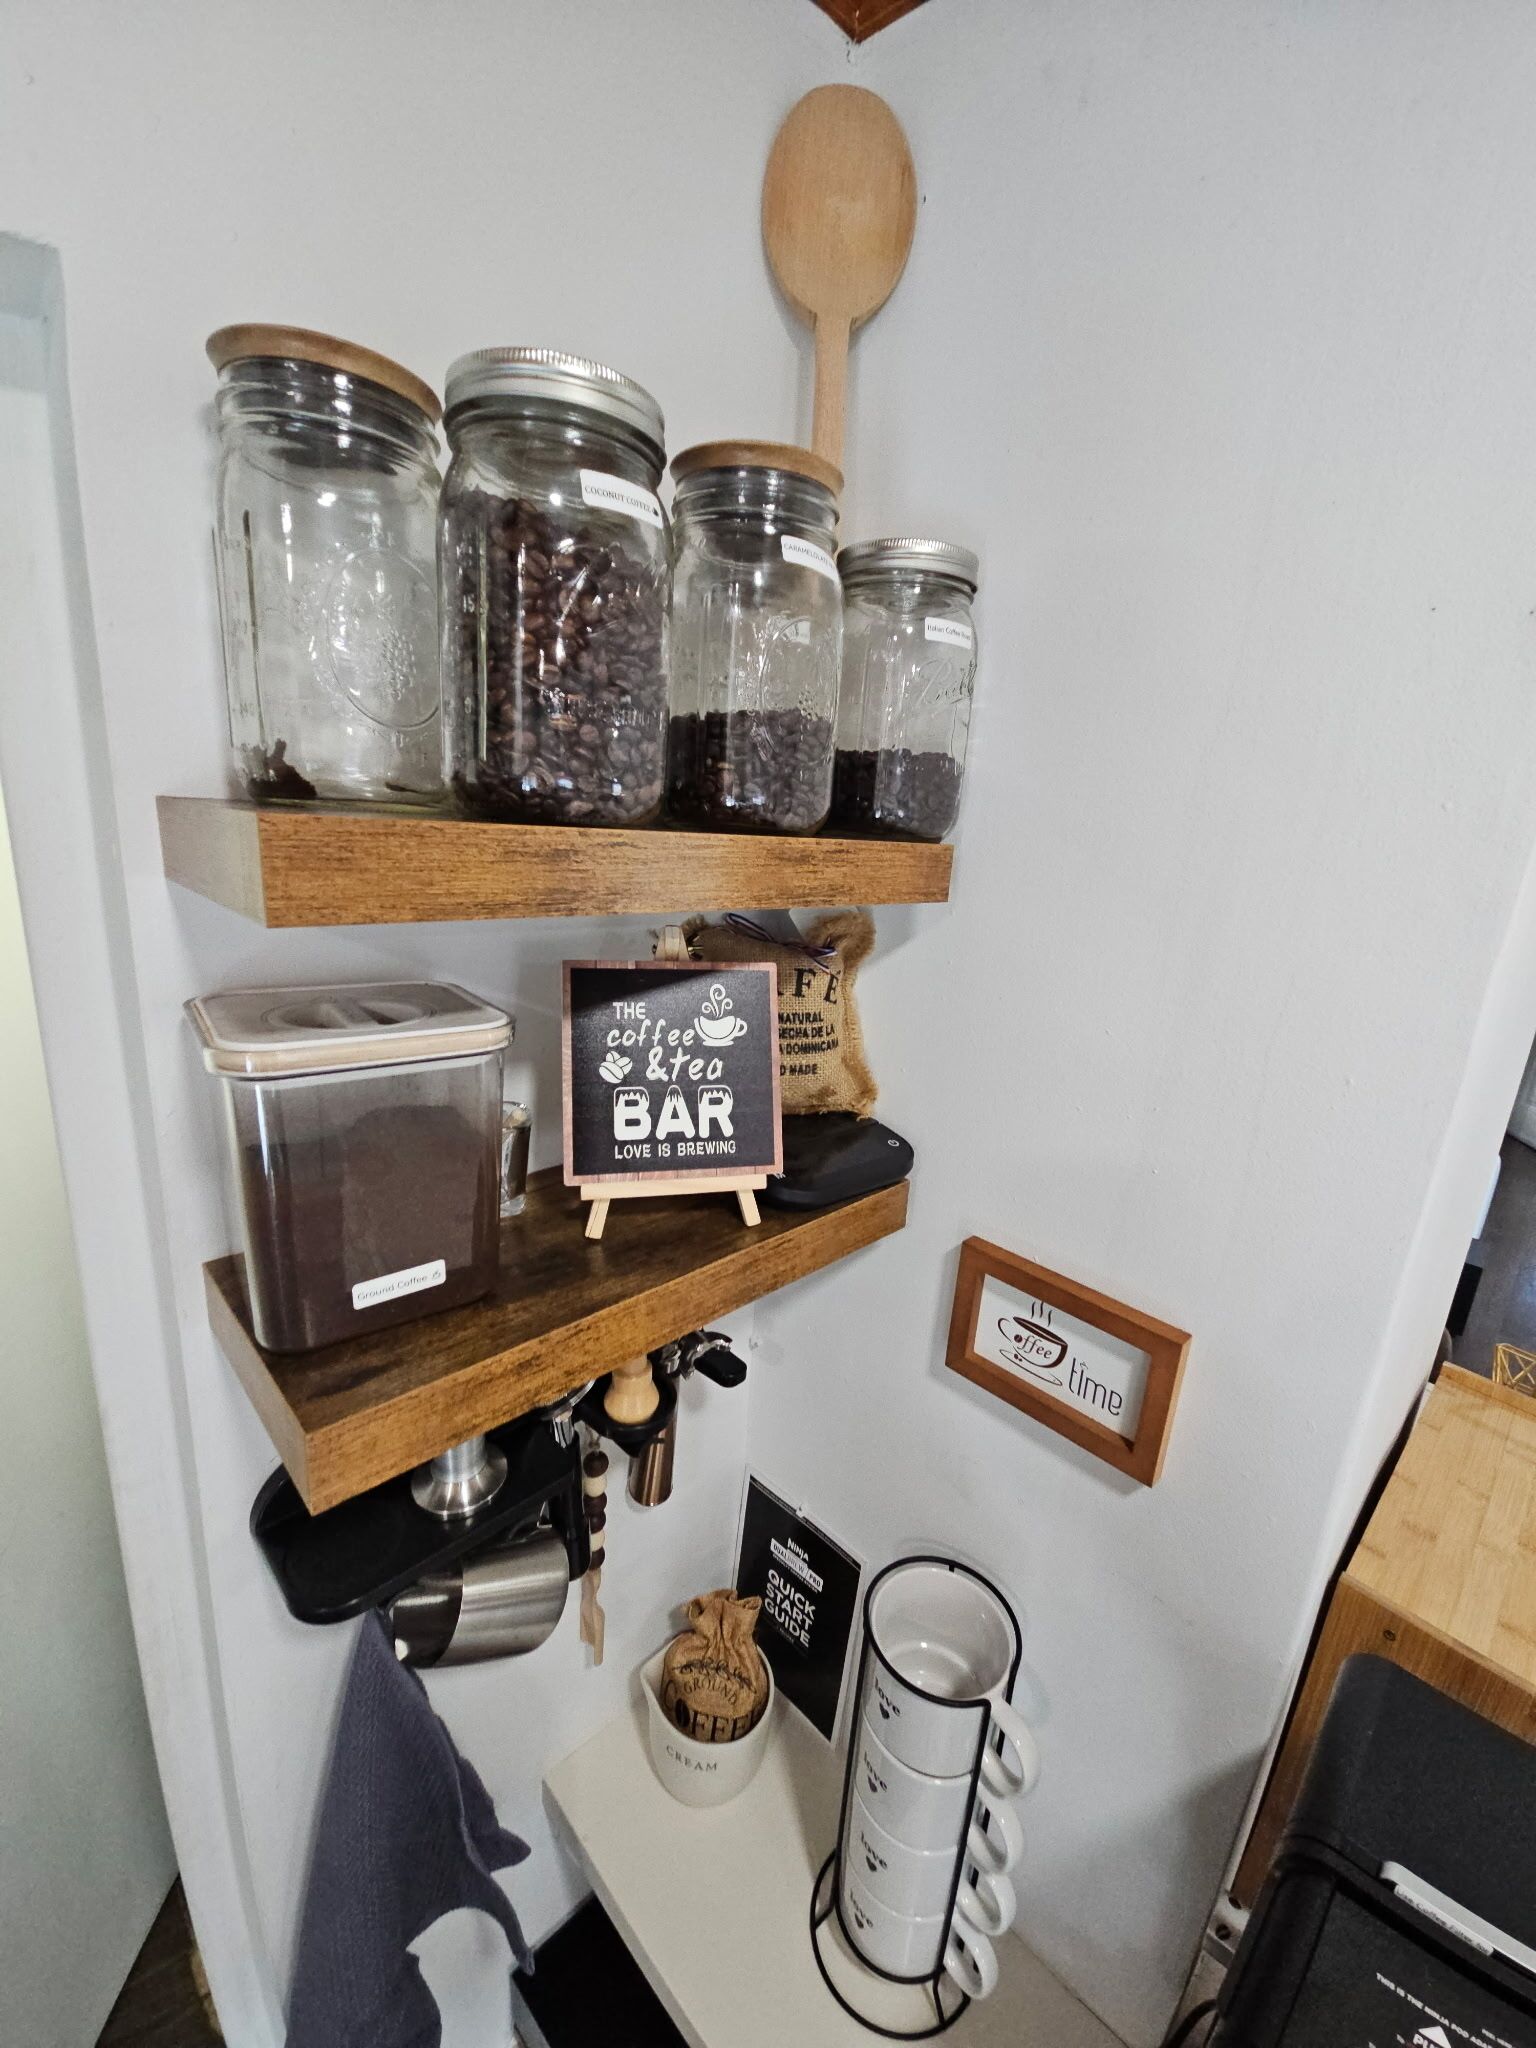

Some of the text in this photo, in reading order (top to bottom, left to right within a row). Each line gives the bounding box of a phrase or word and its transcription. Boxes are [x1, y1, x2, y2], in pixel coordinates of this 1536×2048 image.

[585, 486, 625, 500] COCONUT
[778, 967, 841, 1005] FÉ
[613, 1001, 646, 1020] THE
[778, 1011, 823, 1025] NATURAL
[606, 1018, 696, 1048] coffee
[811, 1026, 824, 1038] DE
[826, 1024, 836, 1036] LA
[789, 1063, 818, 1077] MADE
[613, 1084, 734, 1141] BAR
[614, 1140, 737, 1160] LOVE IS BREWING
[357, 1274, 428, 1302] Ground Coffee
[1068, 1357, 1123, 1417] time
[787, 1537, 809, 1562] NINJA
[766, 1583, 813, 1631] START
[768, 1569, 816, 1620] QUICK
[764, 1599, 811, 1648] GUIDE
[683, 1677, 738, 1706] GROUND
[874, 1675, 901, 1717] love
[666, 1744, 718, 1772] CREAM
[864, 1750, 888, 1793] love
[860, 1830, 888, 1870] love
